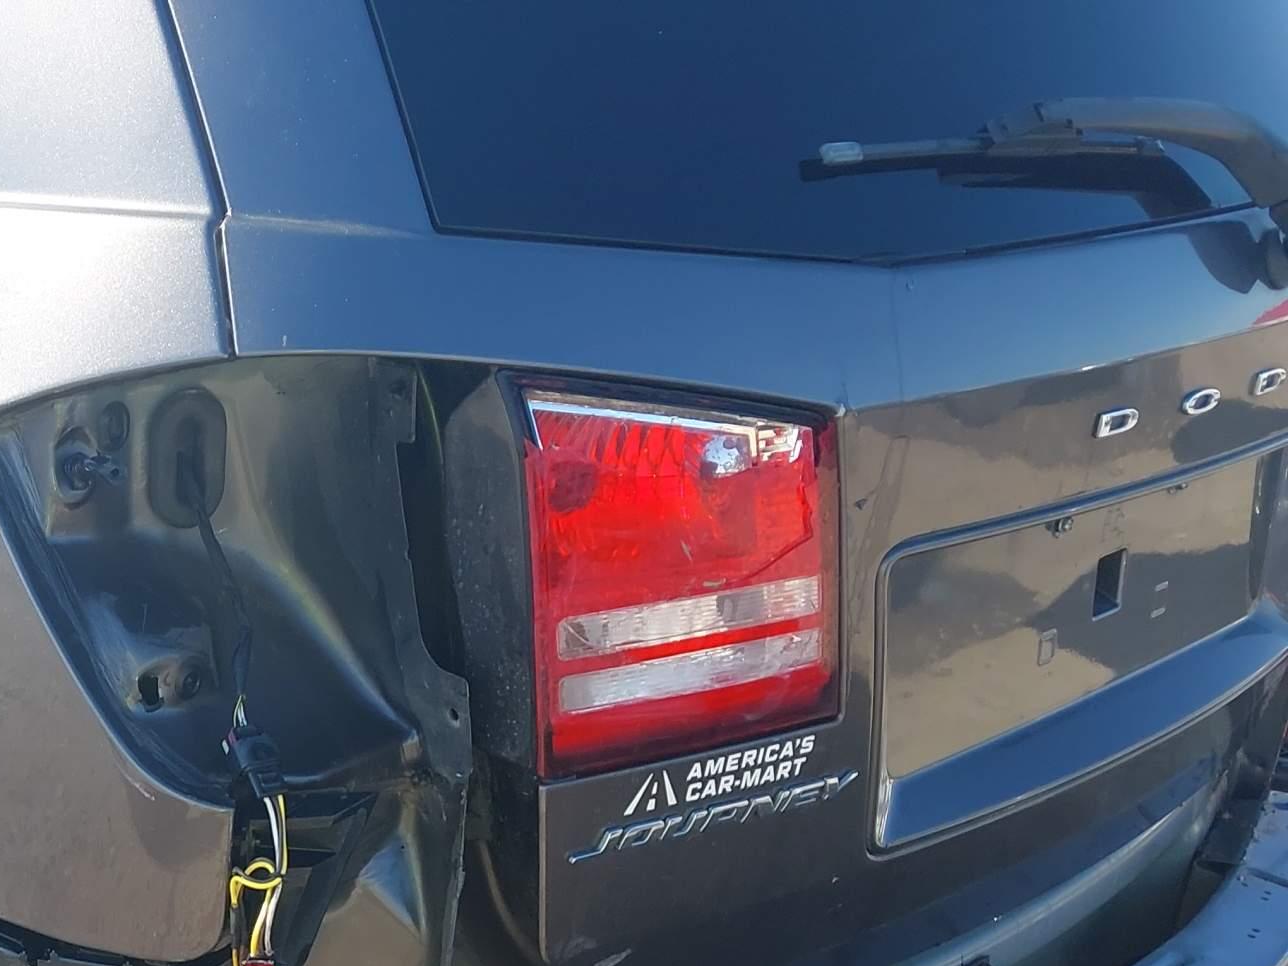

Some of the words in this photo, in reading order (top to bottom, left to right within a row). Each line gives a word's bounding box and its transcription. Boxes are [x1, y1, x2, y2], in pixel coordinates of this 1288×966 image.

[686, 735, 816, 781] AMERICA'S
[686, 757, 807, 802] CAR-MART
[568, 770, 859, 864] JOURNEY
